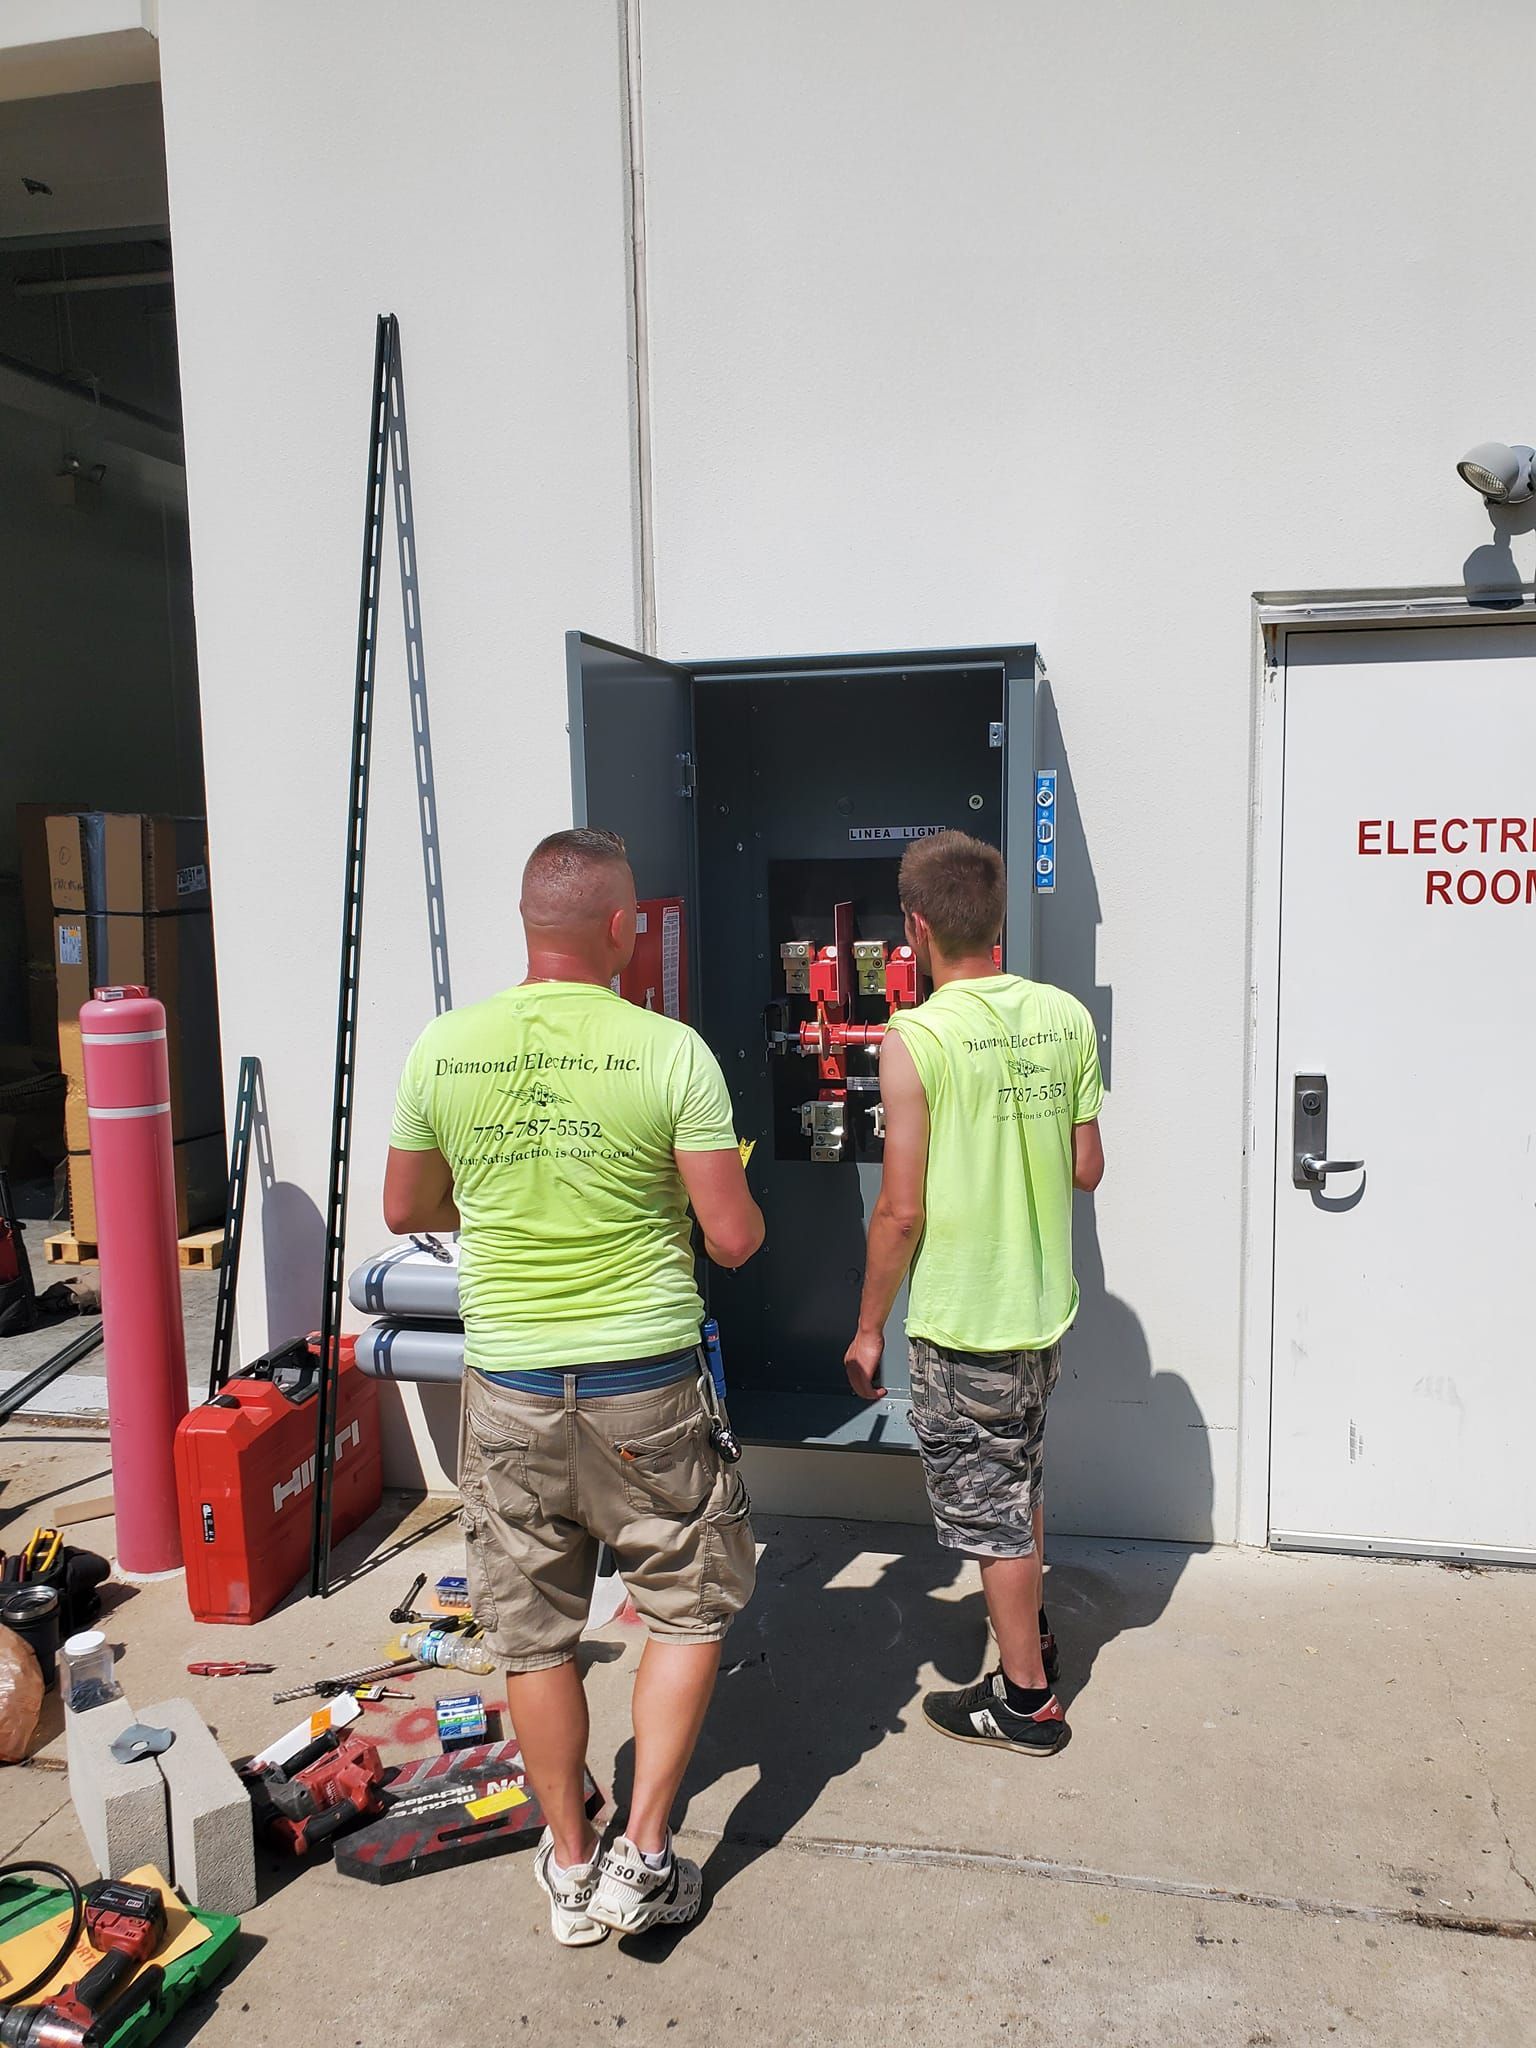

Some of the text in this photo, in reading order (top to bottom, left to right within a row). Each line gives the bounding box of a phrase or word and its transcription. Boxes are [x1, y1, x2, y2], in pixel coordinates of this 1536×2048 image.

[850, 829, 891, 839] LINEA
[435, 1053, 641, 1076] Diamond Electric, Inc.
[473, 1119, 603, 1144] 773-787-5552
[555, 1147, 567, 1158] is
[570, 1147, 597, 1158] Our
[614, 1864, 635, 1880] SO
[574, 1888, 593, 1904] SO
